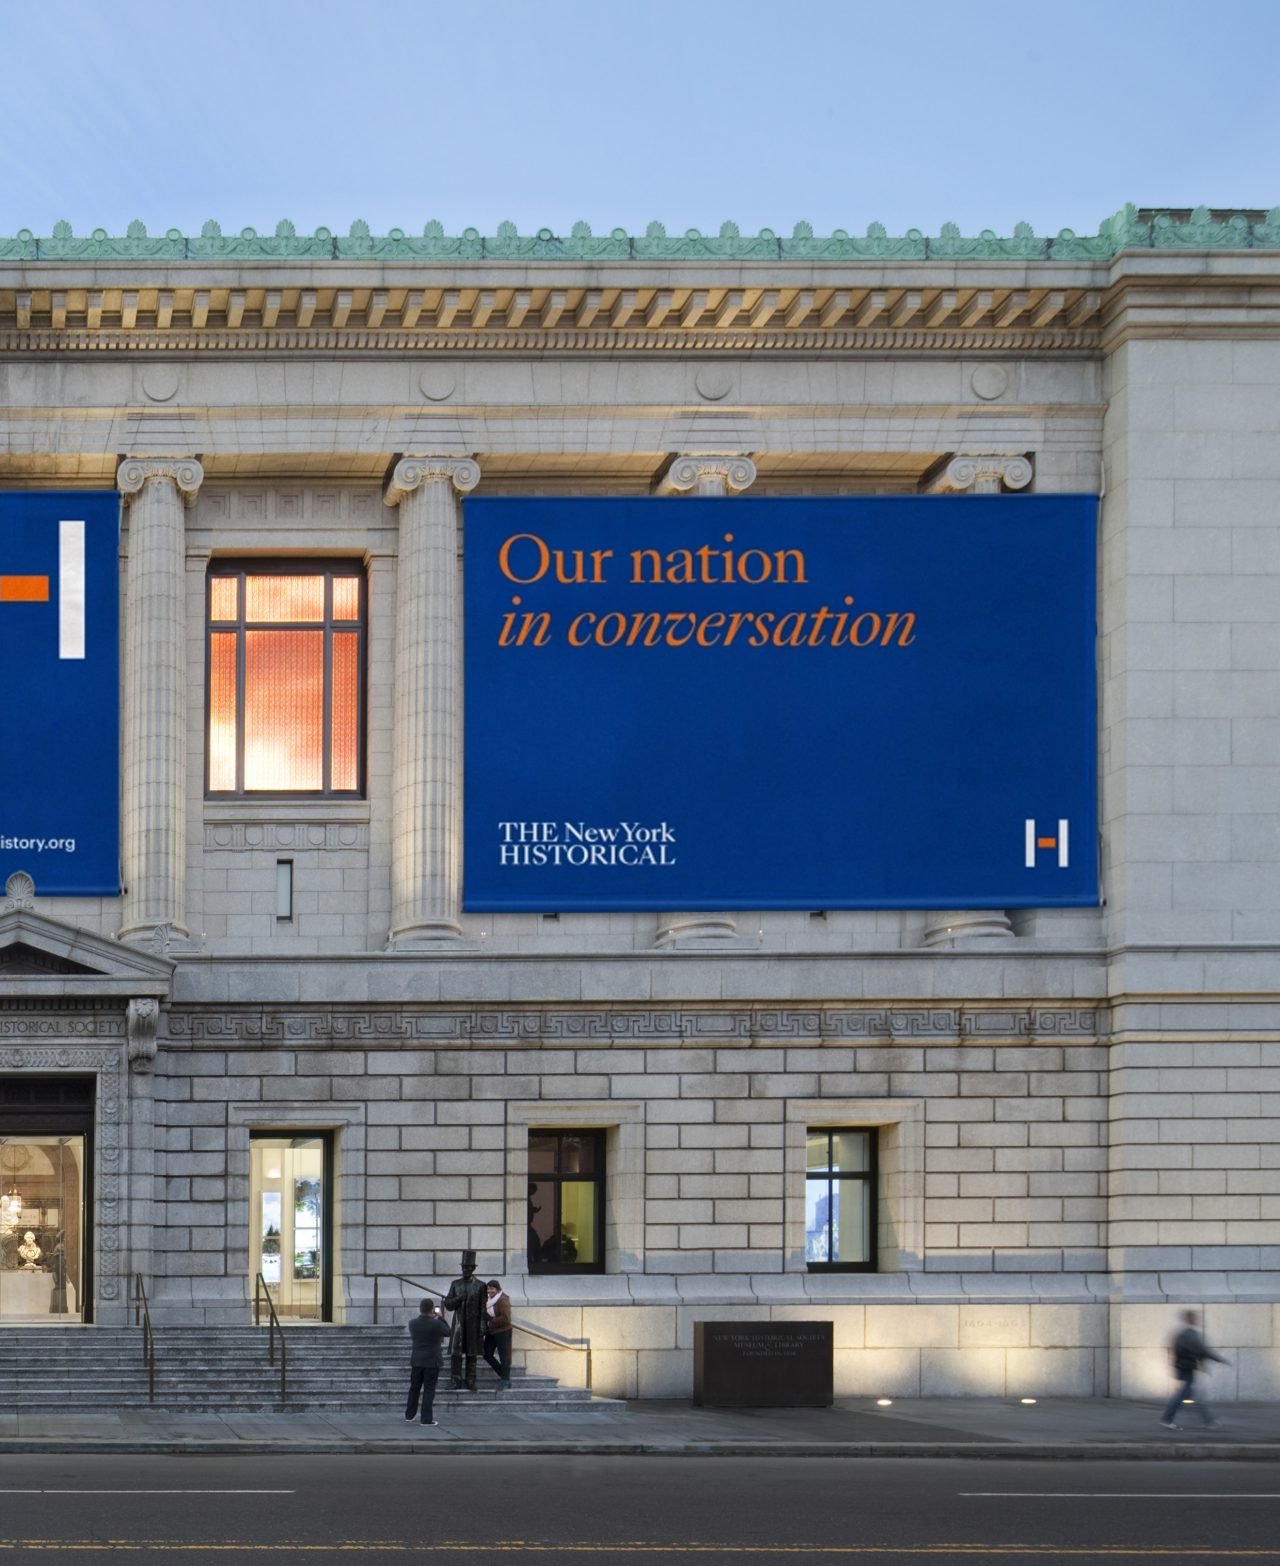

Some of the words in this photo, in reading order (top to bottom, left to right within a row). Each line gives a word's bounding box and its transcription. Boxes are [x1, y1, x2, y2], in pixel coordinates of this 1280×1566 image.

[499, 533, 613, 584] Our
[631, 532, 808, 584] nation
[497, 595, 551, 647] in
[568, 595, 916, 647] conversation
[498, 822, 559, 843] THE
[500, 844, 676, 865] HISTORICAL
[67, 1020, 123, 1034] SOCIETY
